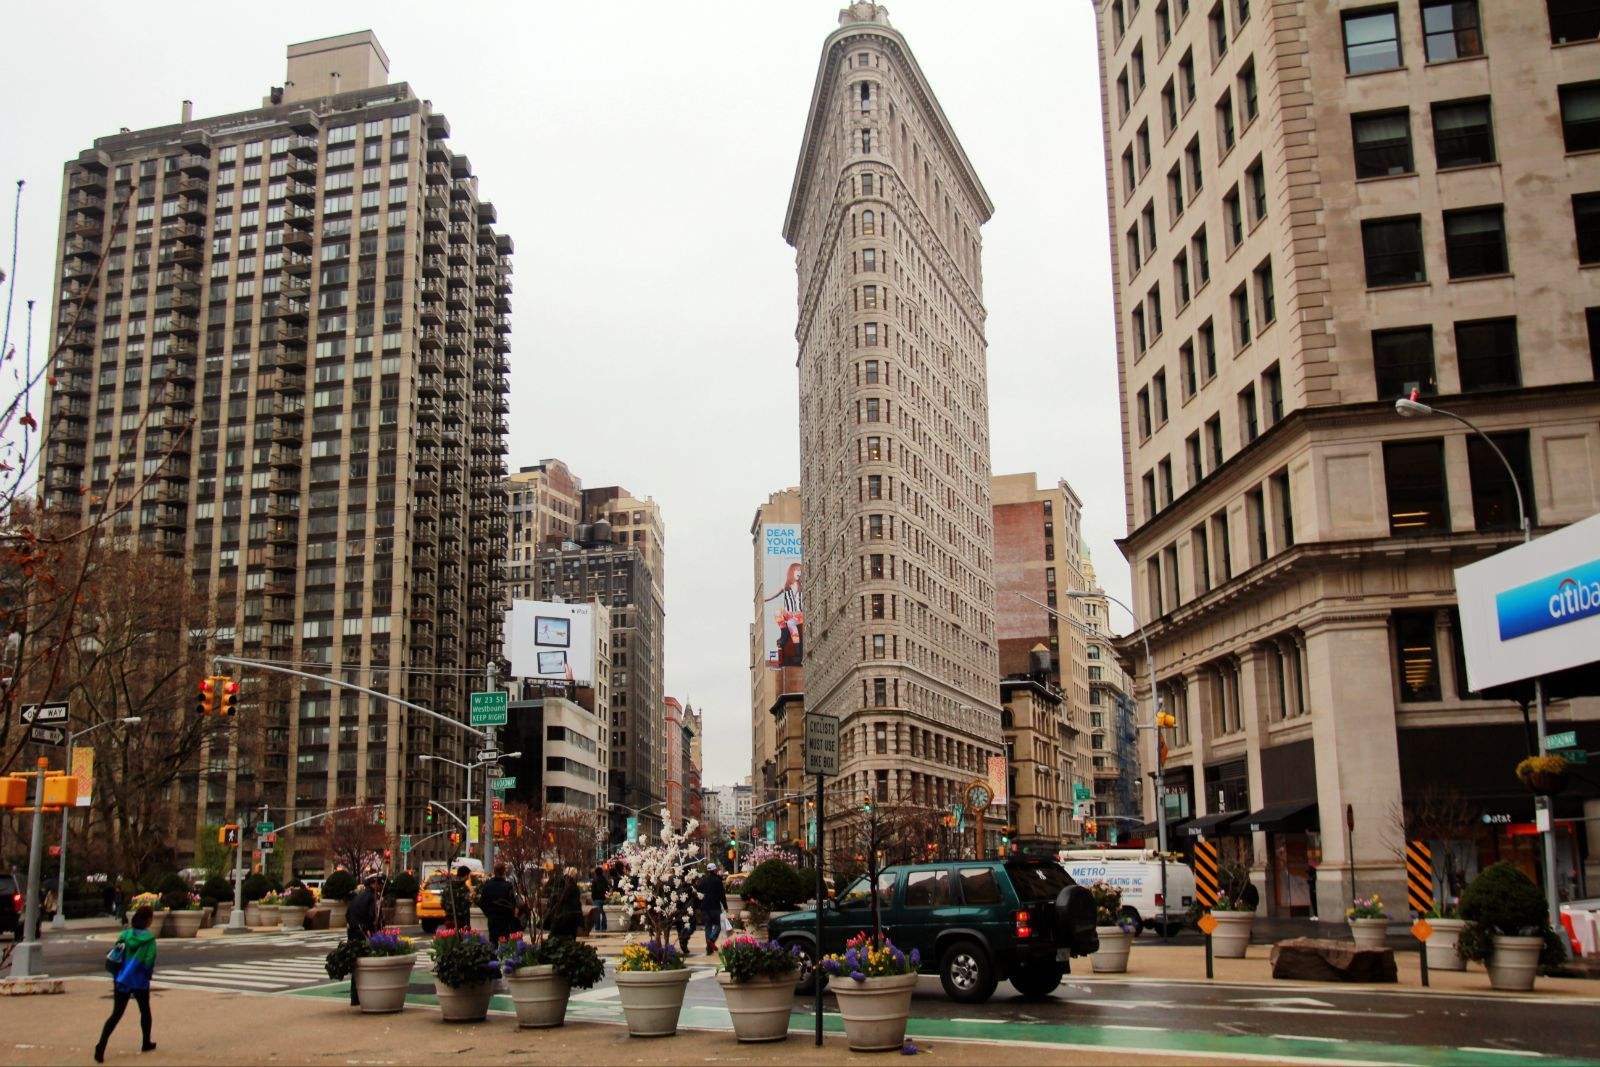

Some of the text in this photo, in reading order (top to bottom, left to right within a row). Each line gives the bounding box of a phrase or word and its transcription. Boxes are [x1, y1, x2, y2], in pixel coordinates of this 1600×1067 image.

[767, 528, 795, 537] DEAR
[475, 696, 481, 704] W
[48, 708, 63, 717] WAY
[473, 713, 505, 722] KEEP RIGHT
[810, 720, 835, 735] CYCLISTS
[810, 738, 835, 752] MUST USE
[810, 754, 834, 768] BIKE BOX
[1072, 867, 1106, 876] METRO
